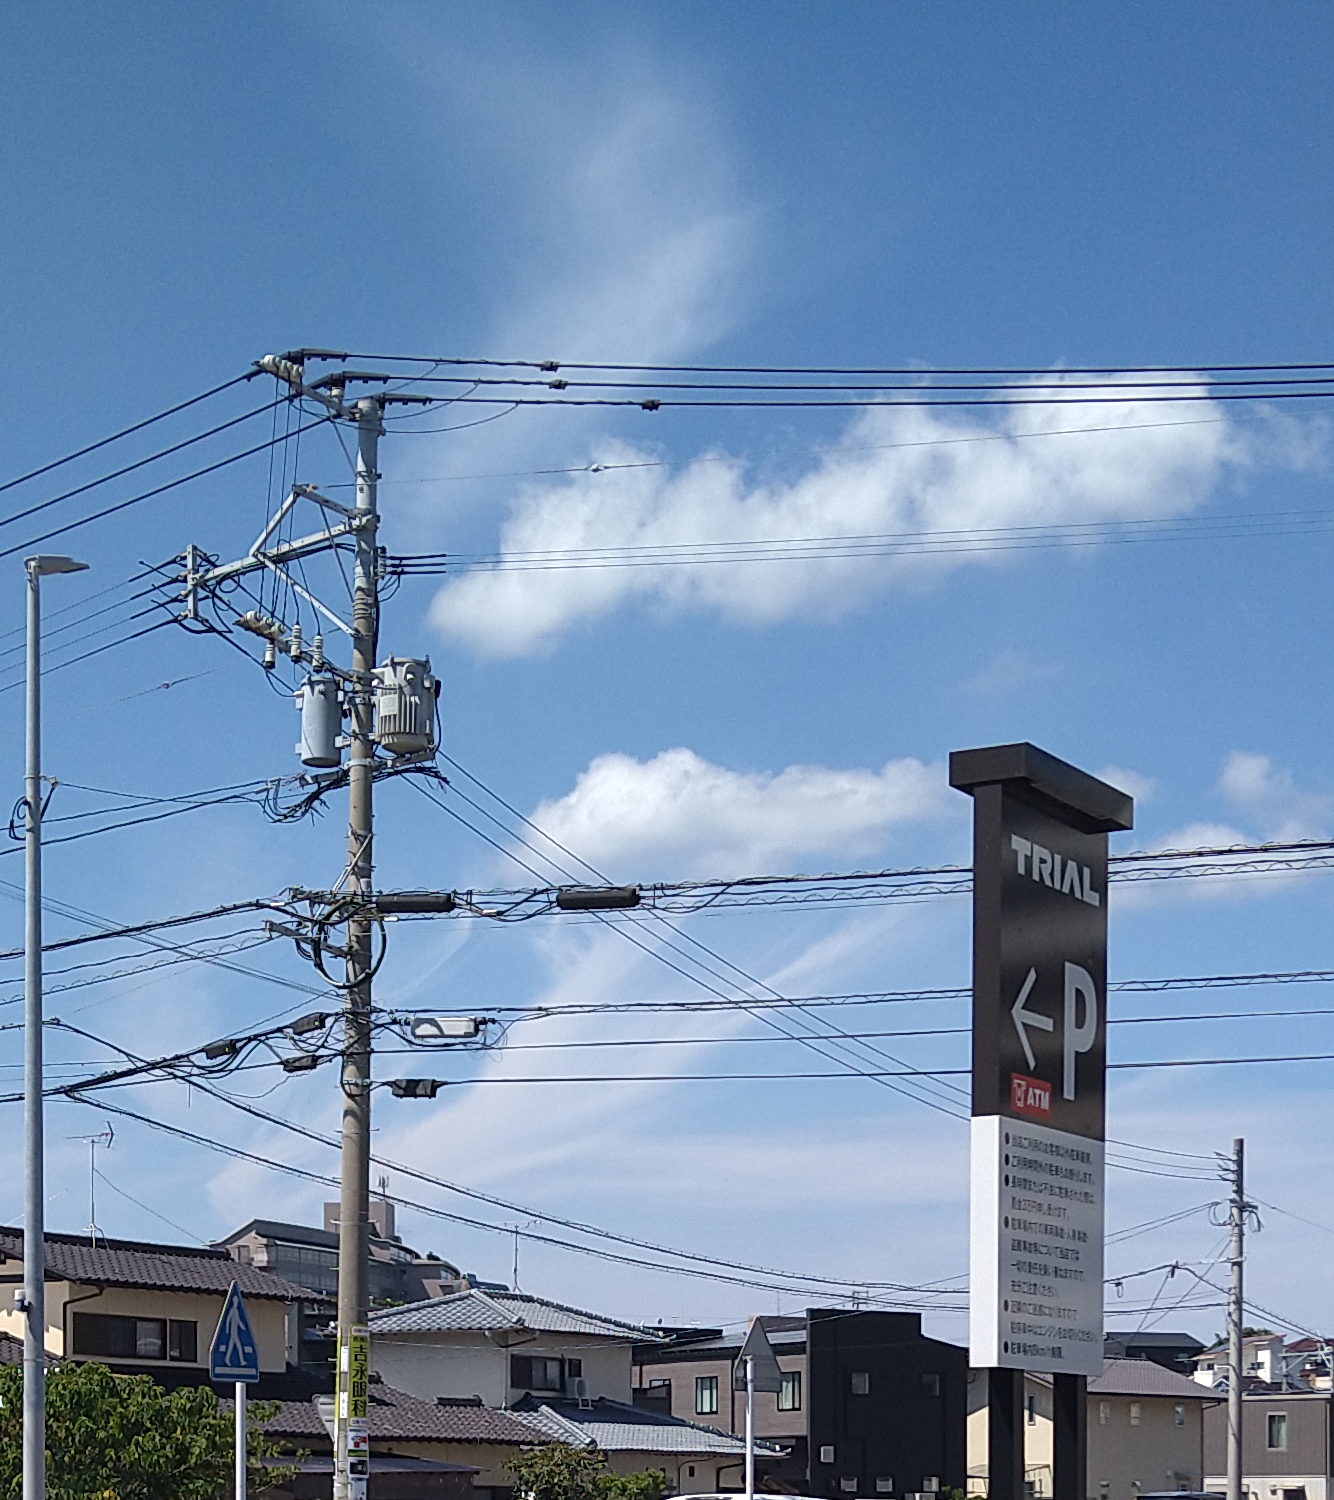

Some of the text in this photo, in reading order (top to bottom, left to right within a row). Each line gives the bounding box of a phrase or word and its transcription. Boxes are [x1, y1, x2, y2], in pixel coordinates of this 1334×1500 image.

[1011, 833, 1100, 907] TRIAL
[1063, 960, 1098, 1101] P
[1026, 1087, 1050, 1111] ATM
[351, 1344, 368, 1417] 吉永眼科
